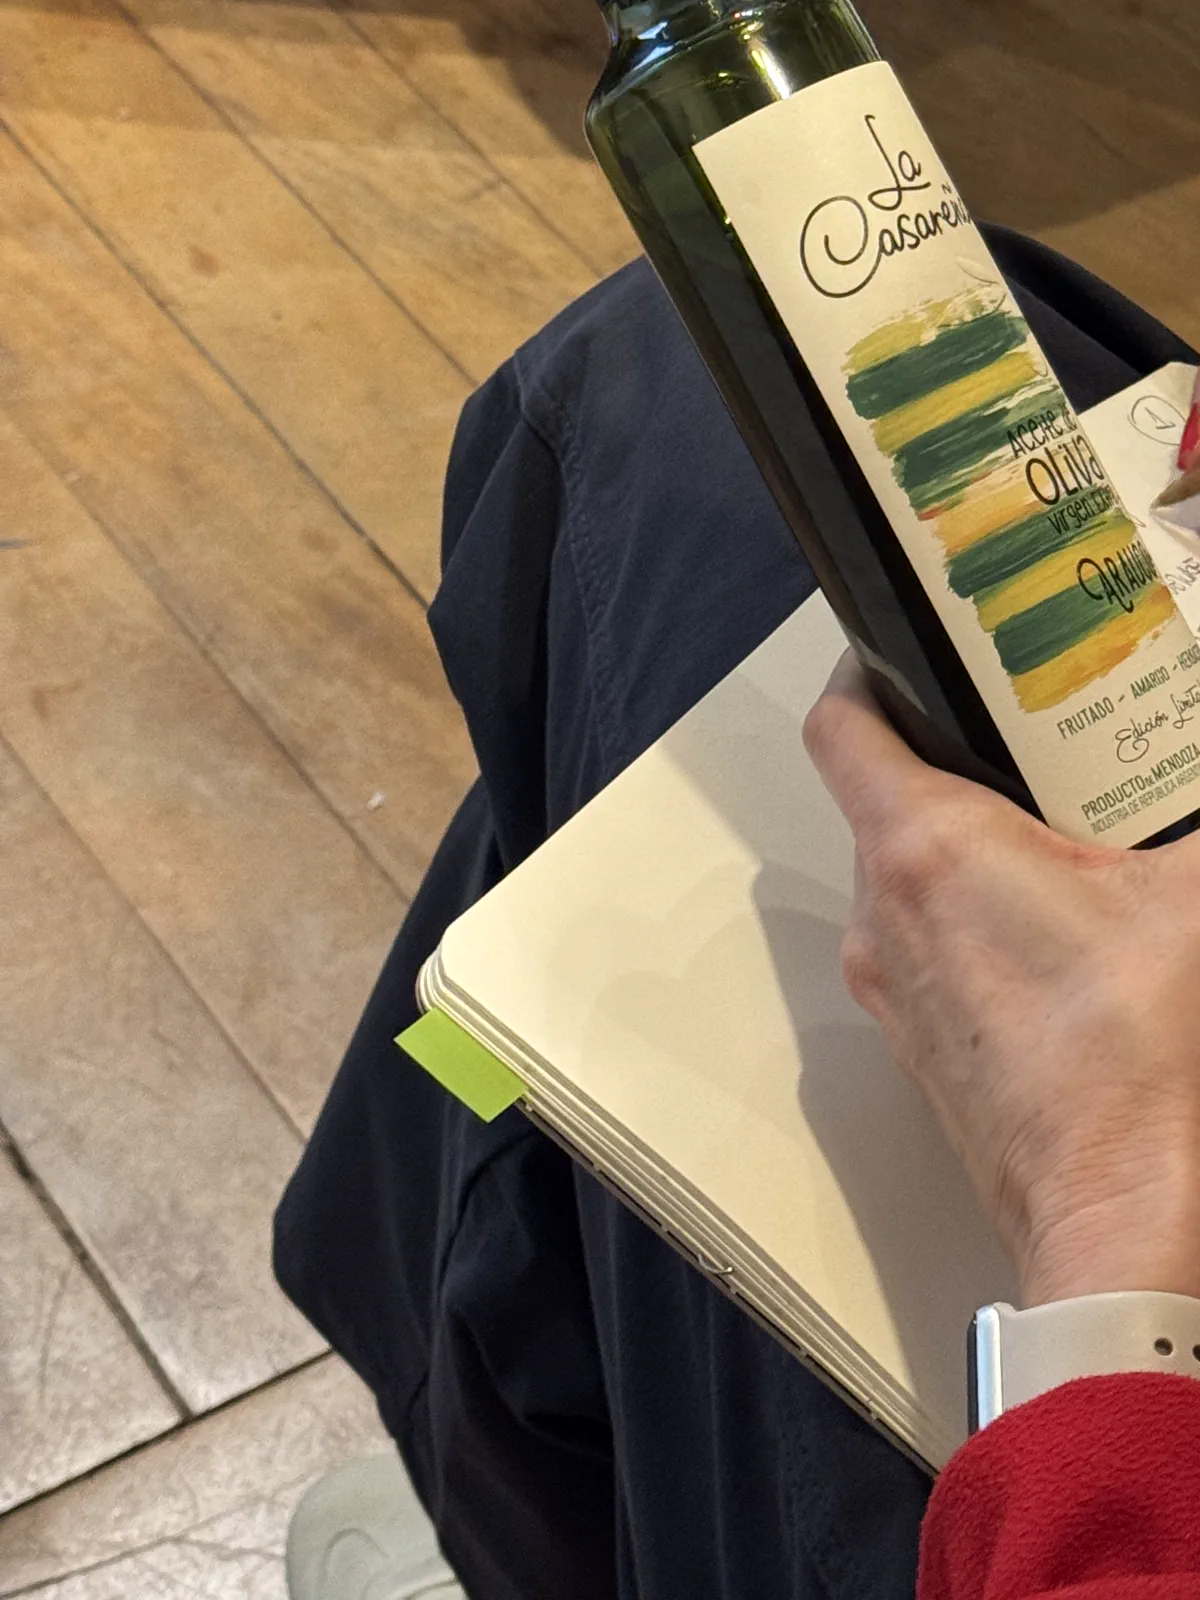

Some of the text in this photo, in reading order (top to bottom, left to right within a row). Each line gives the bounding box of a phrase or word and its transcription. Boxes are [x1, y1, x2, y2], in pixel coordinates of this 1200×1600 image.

[864, 114, 932, 211] La
[799, 180, 972, 299] Casareñ
[1056, 697, 1115, 740] FRUTADO
[1130, 665, 1171, 700] AMARGO
[1114, 709, 1169, 764] Edición
[1081, 774, 1146, 821] PRODUCTO
[1090, 804, 1130, 836] INDUSTRIA
[1129, 801, 1141, 817] DE
